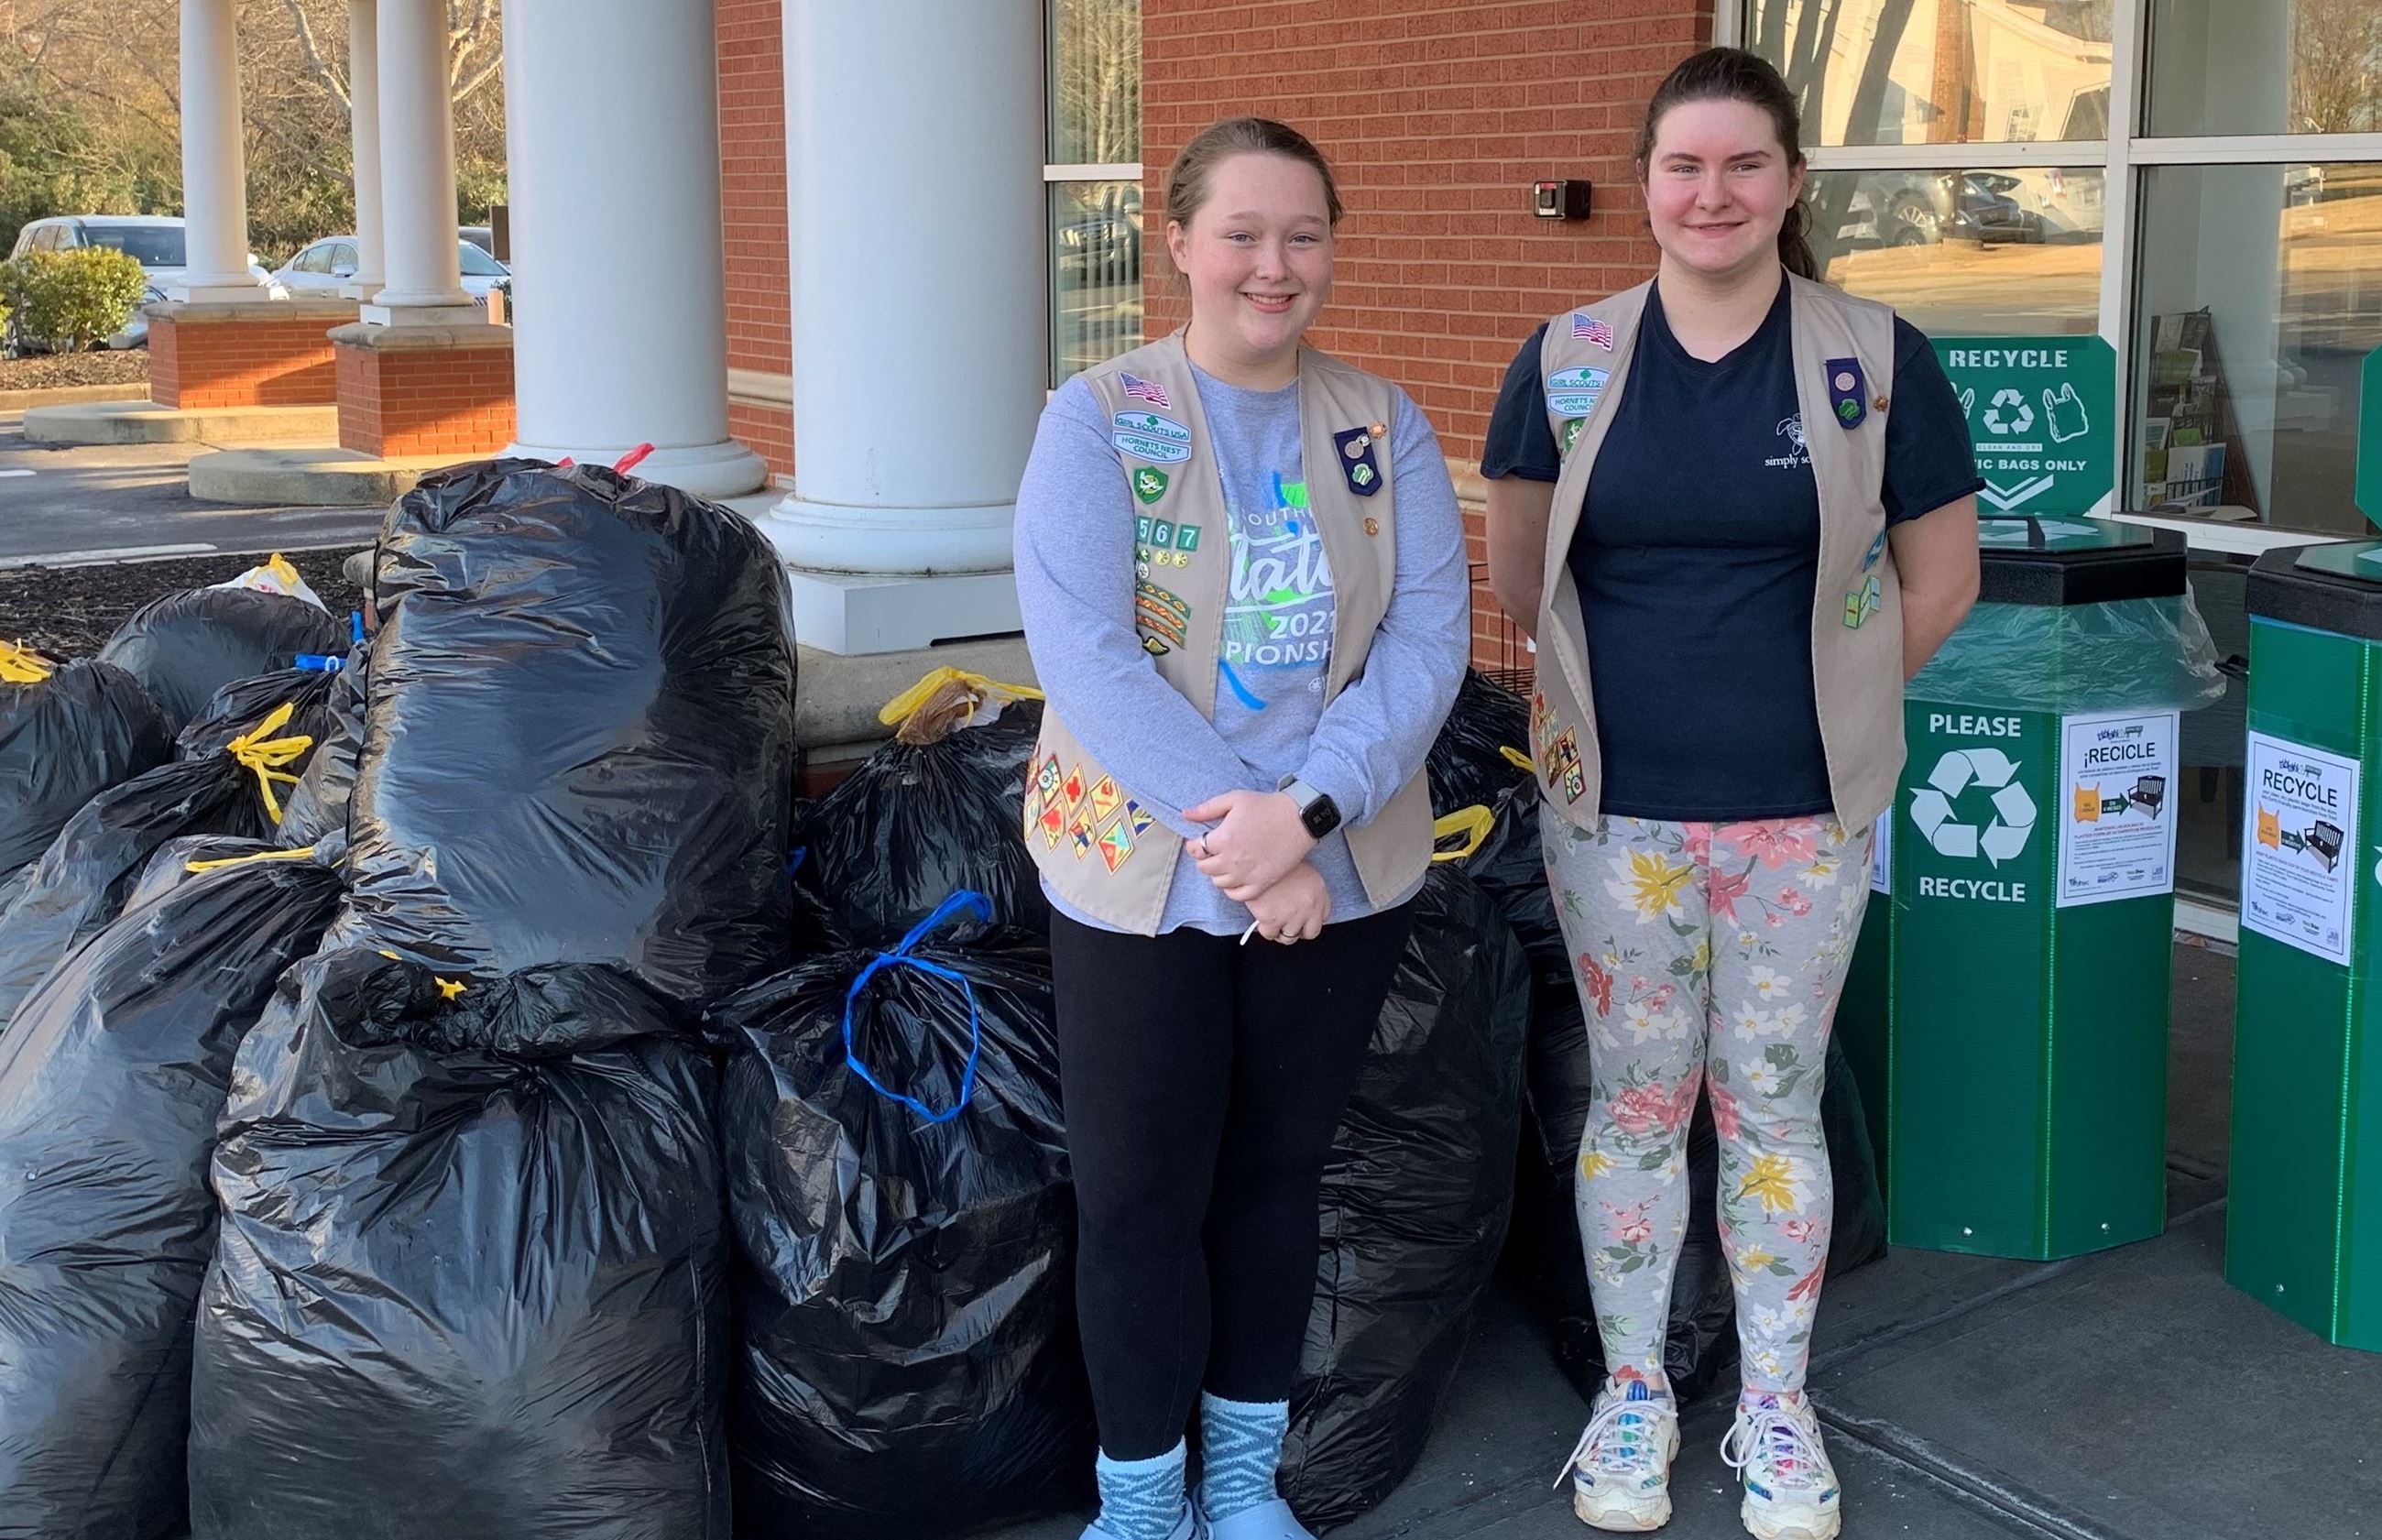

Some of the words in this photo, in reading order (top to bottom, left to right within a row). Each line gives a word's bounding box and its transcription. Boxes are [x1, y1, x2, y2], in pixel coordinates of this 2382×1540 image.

[1949, 350, 2068, 367] RECYCLE
[1137, 422, 1169, 436] SCOUTS
[1171, 430, 1187, 439] USA
[1122, 437, 1159, 449] HORNETS
[1161, 445, 1181, 454] NEST
[1133, 446, 1168, 458] COUNCIL
[1765, 453, 1798, 469] simply
[1998, 459, 2039, 470] BAGS
[2045, 460, 2087, 471] ONLY
[1929, 714, 2022, 737] PLEASE
[2263, 769, 2337, 807] RECYCLE
[1919, 877, 2026, 902] RECYCLE
